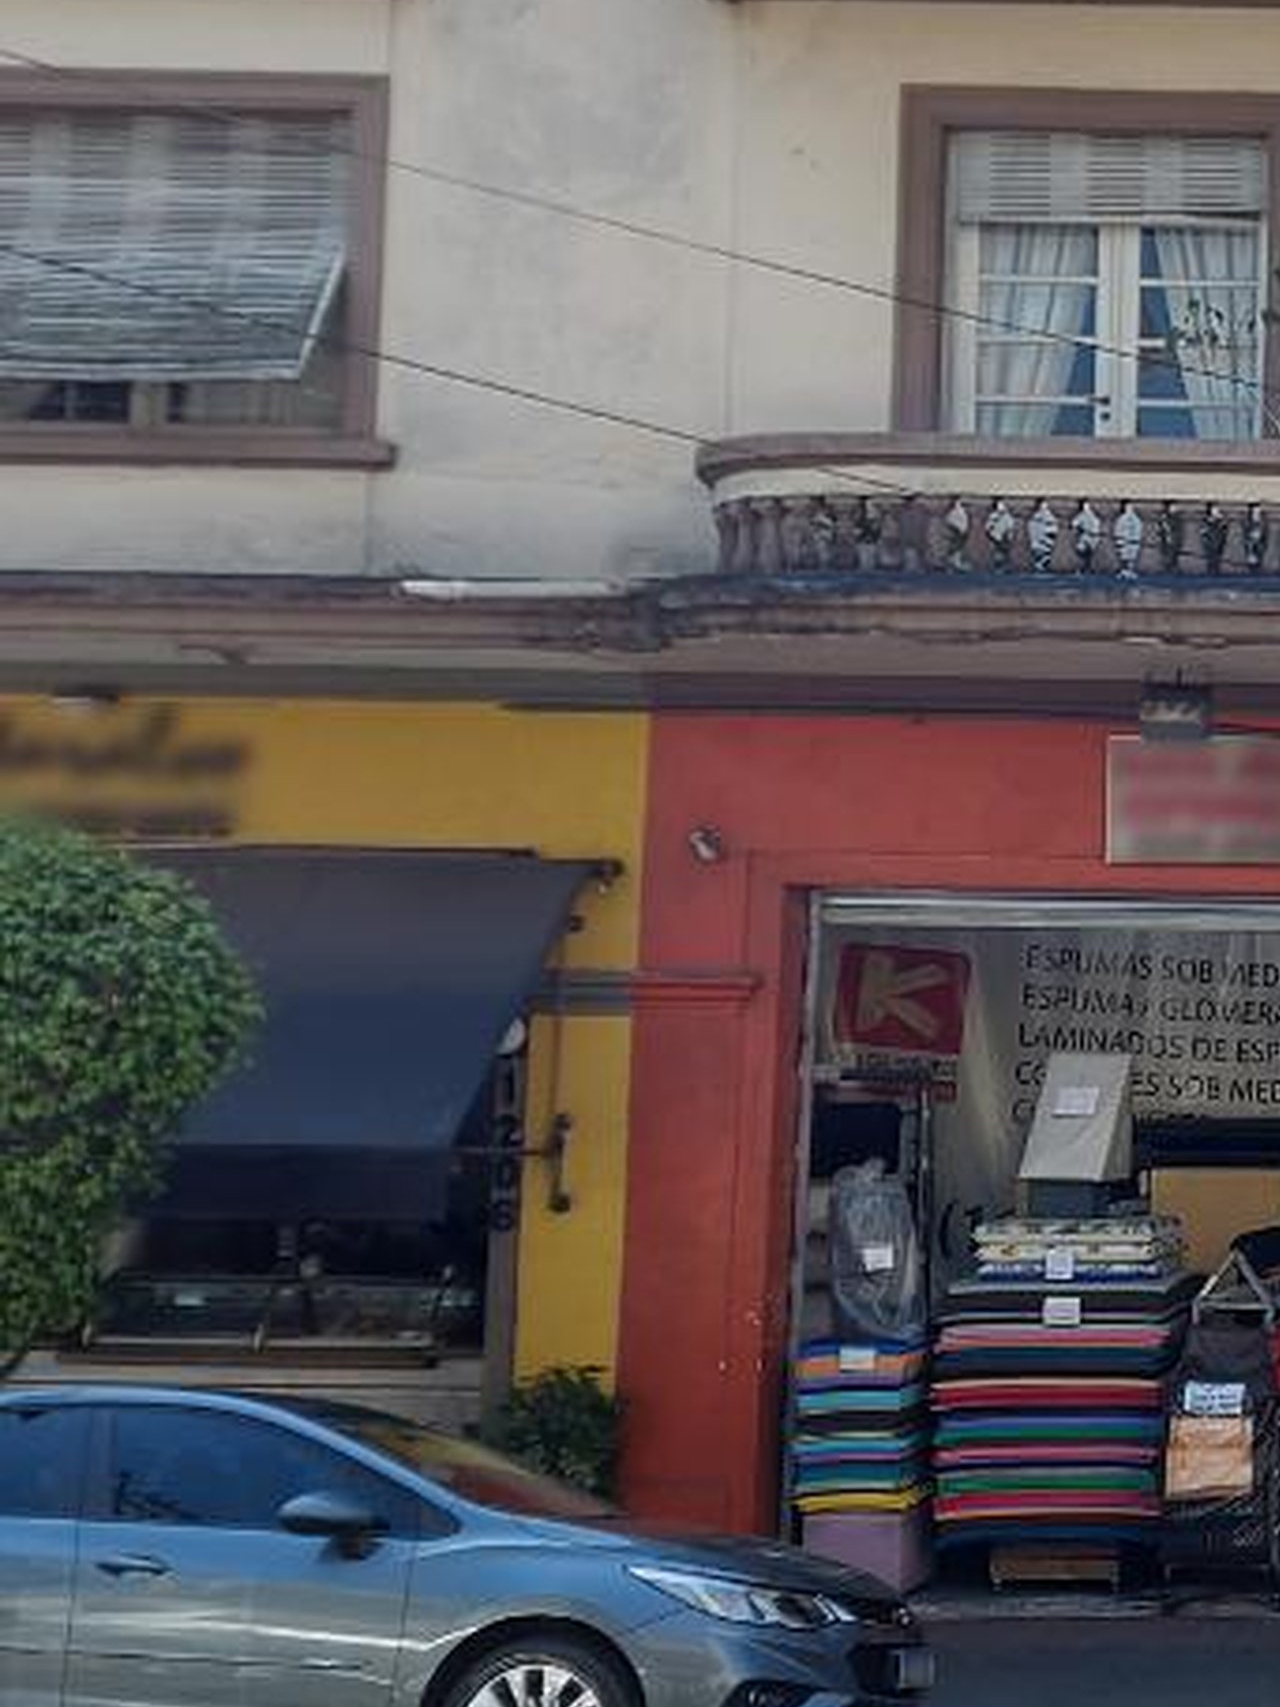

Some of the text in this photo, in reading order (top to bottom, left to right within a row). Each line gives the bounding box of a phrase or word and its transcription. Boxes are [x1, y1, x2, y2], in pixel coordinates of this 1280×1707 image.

[1025, 944, 1153, 980] ESPUMAS
[1161, 954, 1214, 985] SOB
[1017, 1022, 1184, 1060] LAMINADOS
[1191, 1036, 1228, 1063] DE
[1165, 1073, 1221, 1101] SOB
